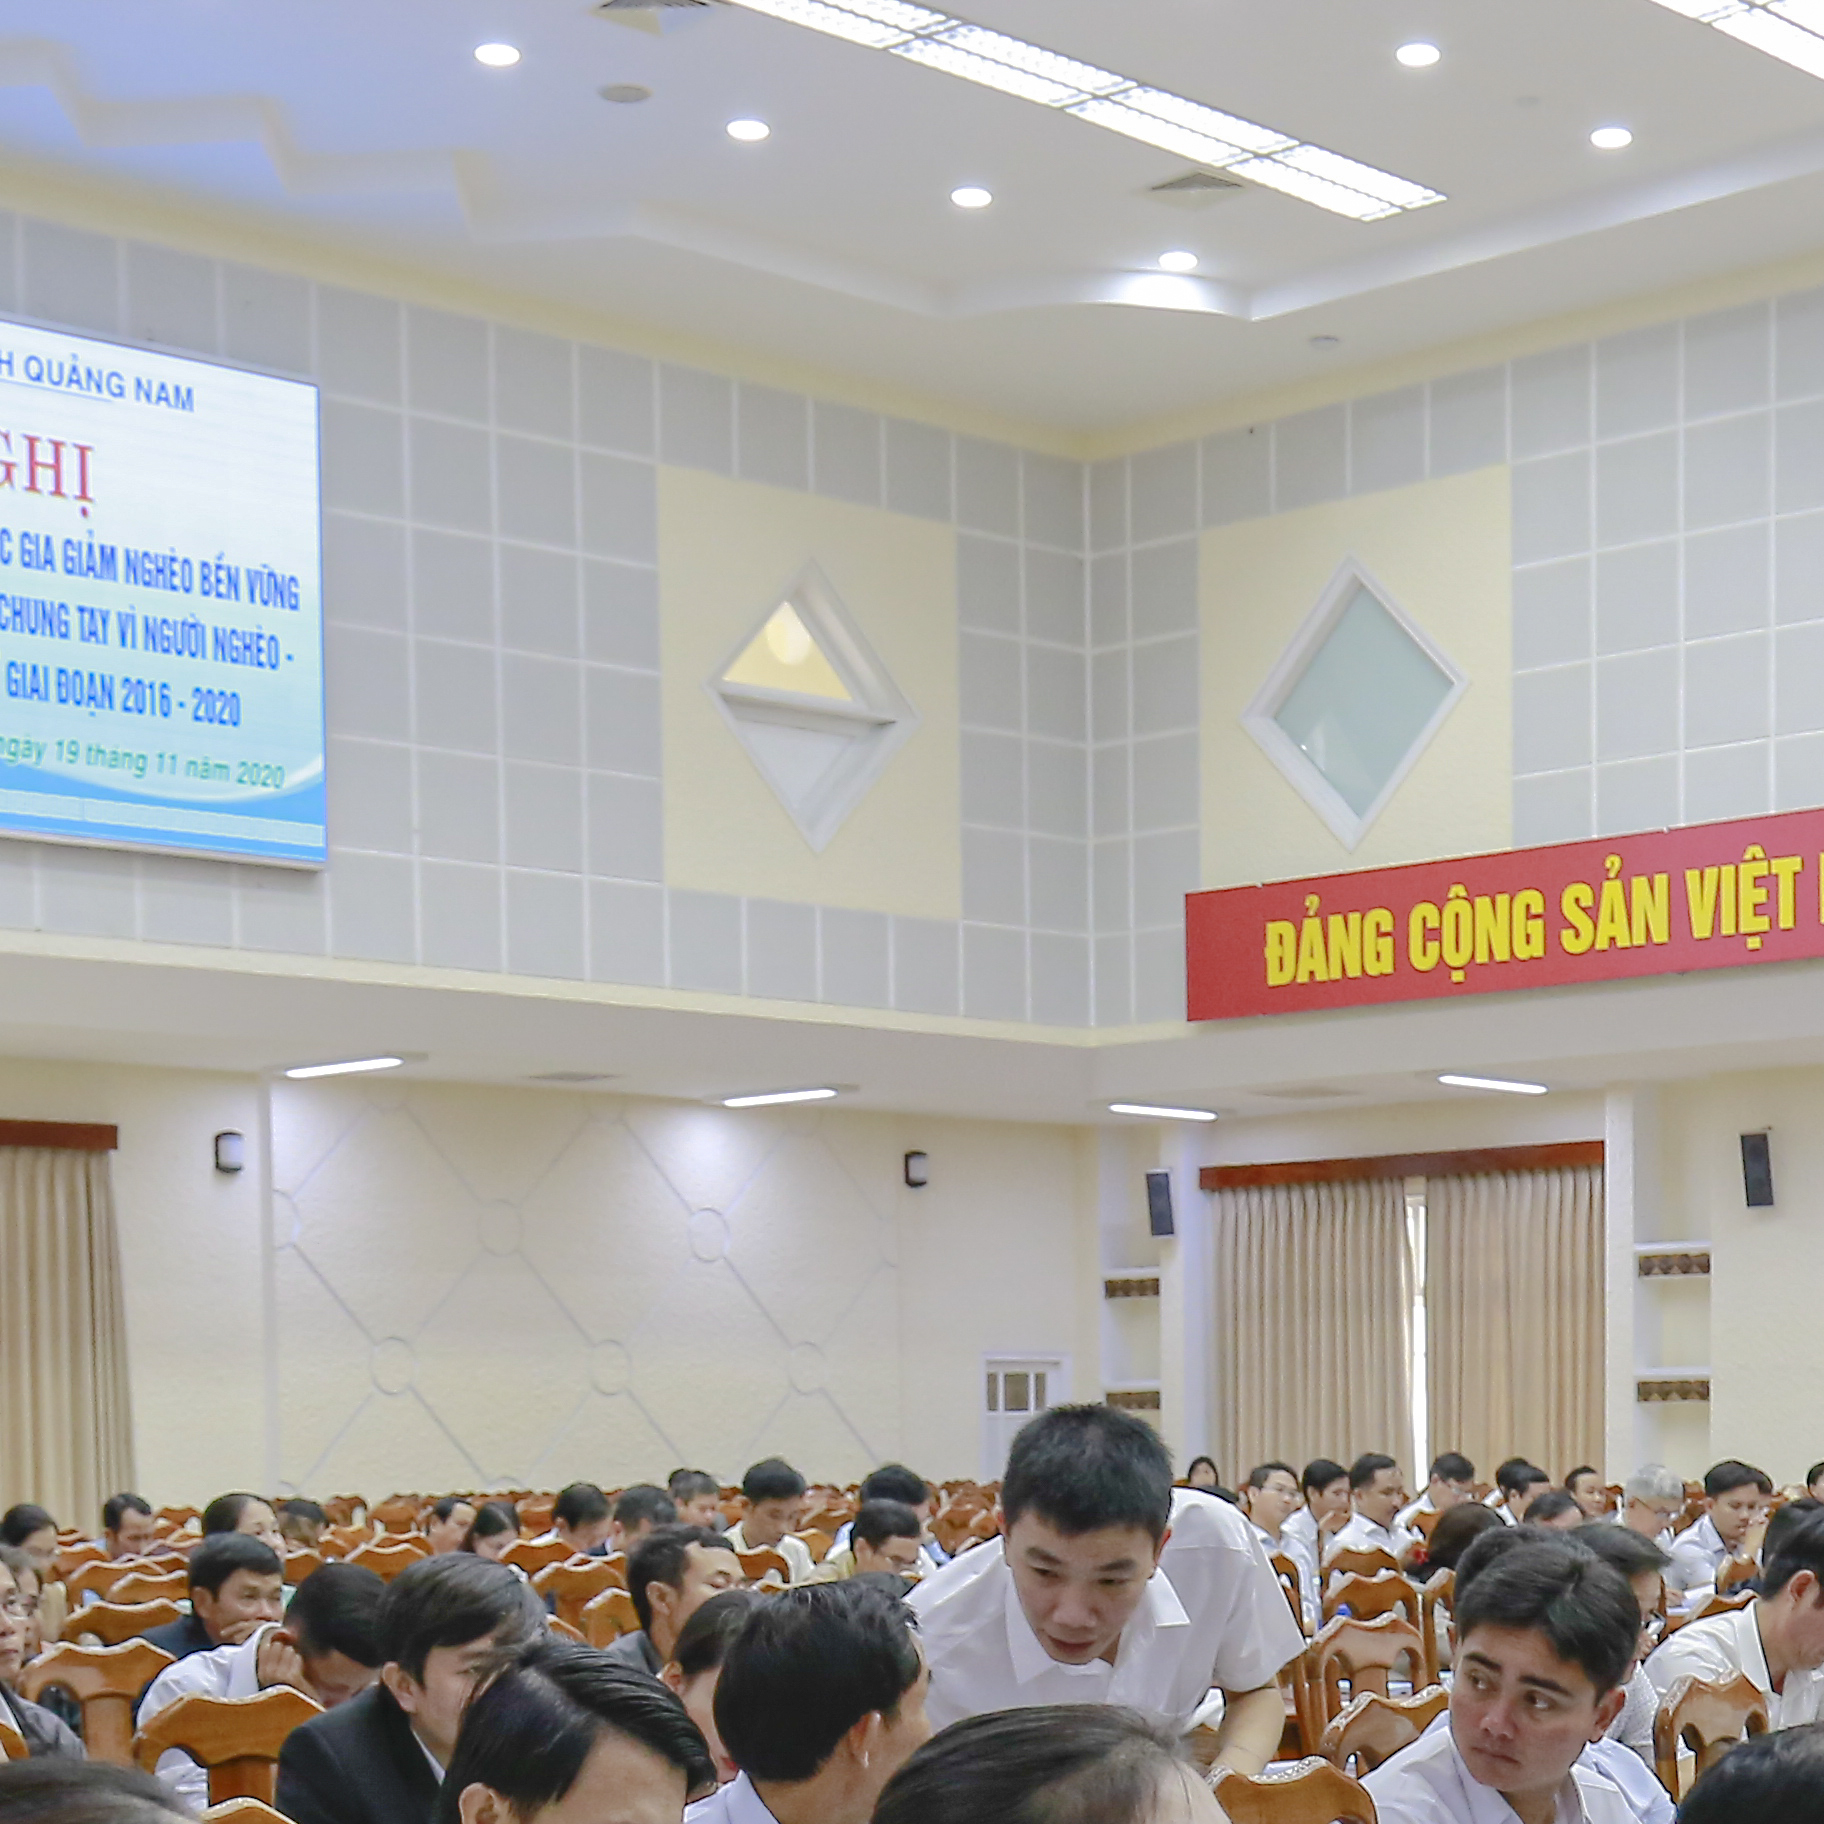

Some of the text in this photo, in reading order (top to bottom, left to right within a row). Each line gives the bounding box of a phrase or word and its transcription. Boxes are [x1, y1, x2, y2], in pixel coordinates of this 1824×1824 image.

[24, 353, 126, 399] QUẢNG
[135, 377, 195, 413] NAM
[20, 531, 56, 573] GIA
[62, 528, 118, 582] GIẢM
[124, 547, 193, 594] NGHÈO
[246, 564, 300, 611] VỮNG
[77, 605, 111, 646] TAY
[117, 604, 137, 650] VÌ
[144, 613, 207, 660] NGƯỜI
[213, 624, 280, 671] NGHÈO
[7, 660, 50, 702] GIAI
[57, 667, 115, 717] ĐOẠN
[121, 677, 172, 719] 2016
[191, 687, 242, 728] 2020
[54, 738, 81, 764] 19
[86, 743, 149, 779] tháng
[155, 750, 177, 775] 11
[184, 757, 231, 782] năm
[235, 760, 286, 789] 2020
[1265, 893, 1393, 987] ĐẢNG
[1405, 883, 1546, 983] CỘNG
[1559, 852, 1671, 953] SẢN
[1687, 843, 1803, 950] VIỆT
